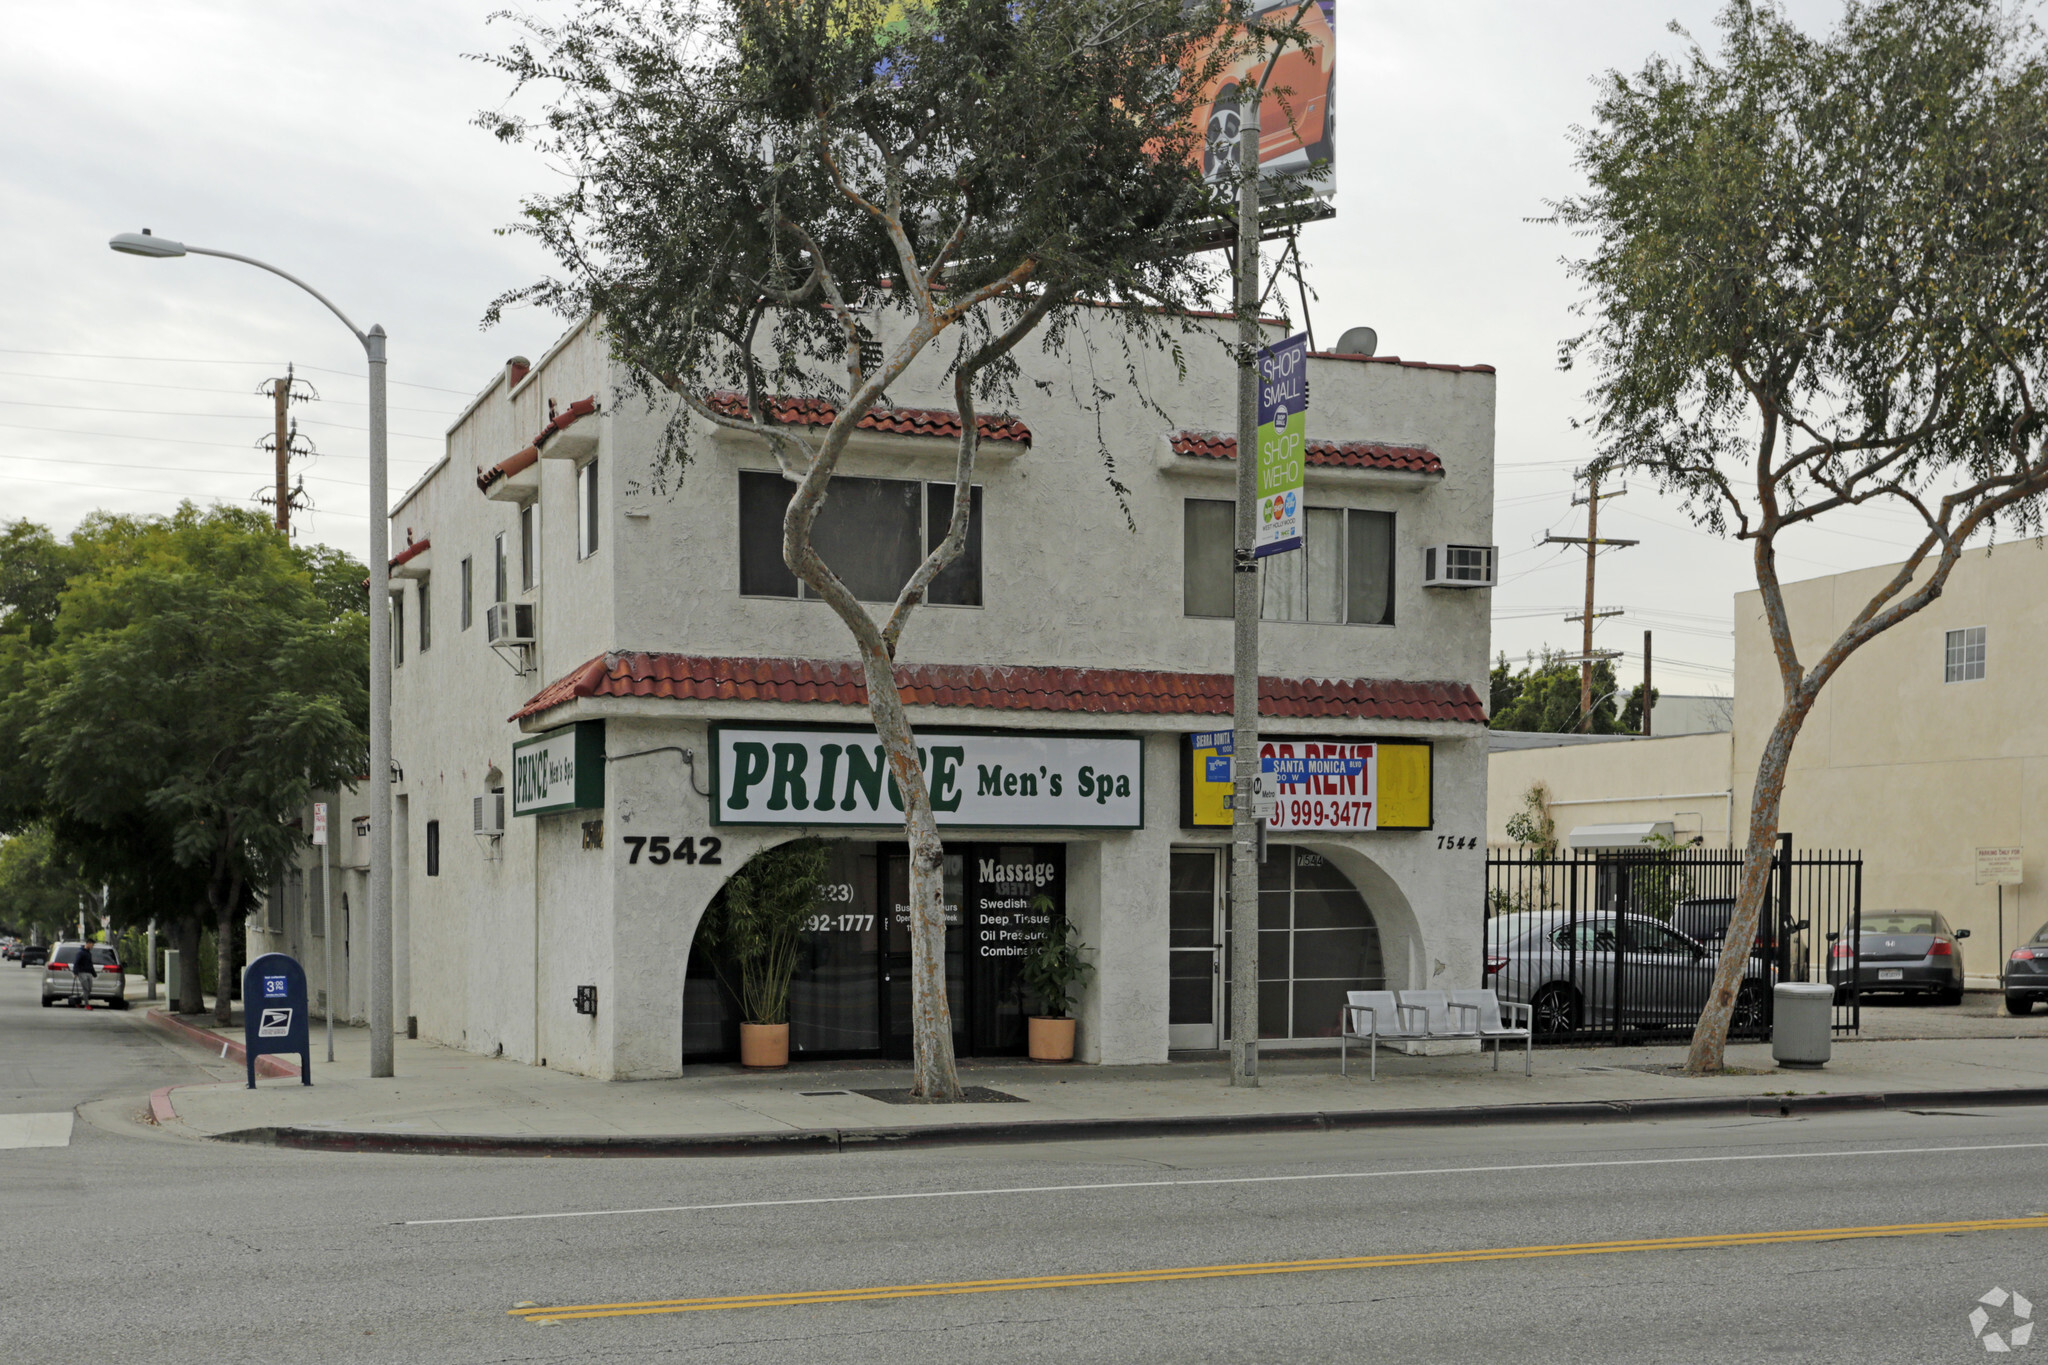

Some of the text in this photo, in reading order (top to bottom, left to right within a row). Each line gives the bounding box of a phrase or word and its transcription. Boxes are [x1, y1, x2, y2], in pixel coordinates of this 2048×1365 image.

[1264, 348, 1301, 384] SHOP
[1264, 378, 1300, 407] SMALL
[1264, 433, 1299, 465] SHOP
[1263, 461, 1298, 489] WEHO
[1196, 734, 1212, 747] SIERRA
[517, 749, 548, 804] PRINCE
[564, 756, 573, 786] Spa
[1273, 760, 1304, 773] SANTA
[1308, 761, 1346, 773] MONICA
[1305, 744, 1373, 796] RENT
[977, 764, 1062, 798] Men's
[1078, 766, 1131, 805] Spa
[1262, 790, 1276, 798] Metro
[624, 836, 722, 865] 7542
[1437, 835, 1477, 850] 7544
[1297, 855, 1322, 867] 7544
[979, 859, 1054, 887] Massage
[980, 898, 1027, 909] Swedish
[800, 914, 874, 932] 92-1777
[980, 914, 1050, 926] Deep Tissue
[980, 930, 996, 941] Oil
